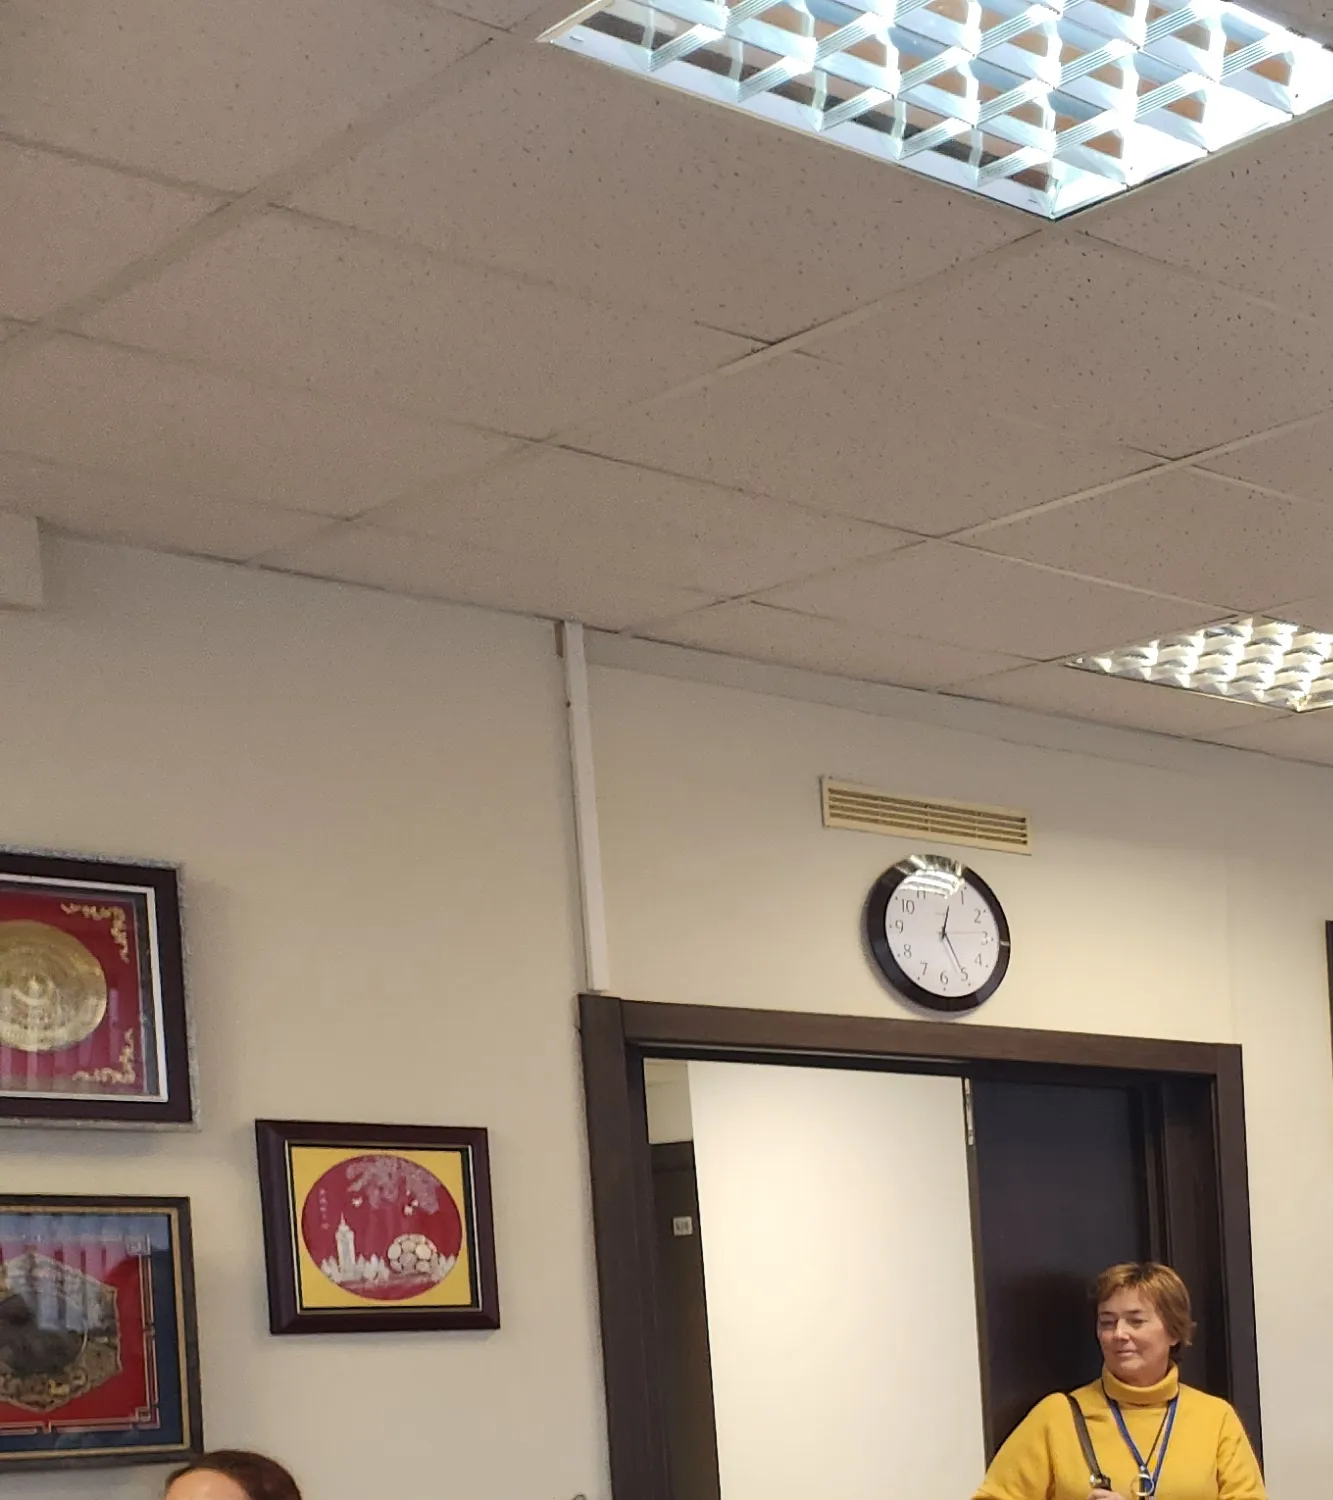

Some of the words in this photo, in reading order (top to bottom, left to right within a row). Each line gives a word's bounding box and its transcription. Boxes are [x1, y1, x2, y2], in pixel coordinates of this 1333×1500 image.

[902, 899, 915, 914] 10
[974, 909, 982, 923] 2
[895, 920, 904, 934] 9
[981, 931, 988, 945] 3
[903, 944, 912, 958] 8
[974, 953, 983, 966] 4
[920, 961, 928, 976] 7
[961, 966, 969, 981] 5
[940, 970, 949, 985] 6
